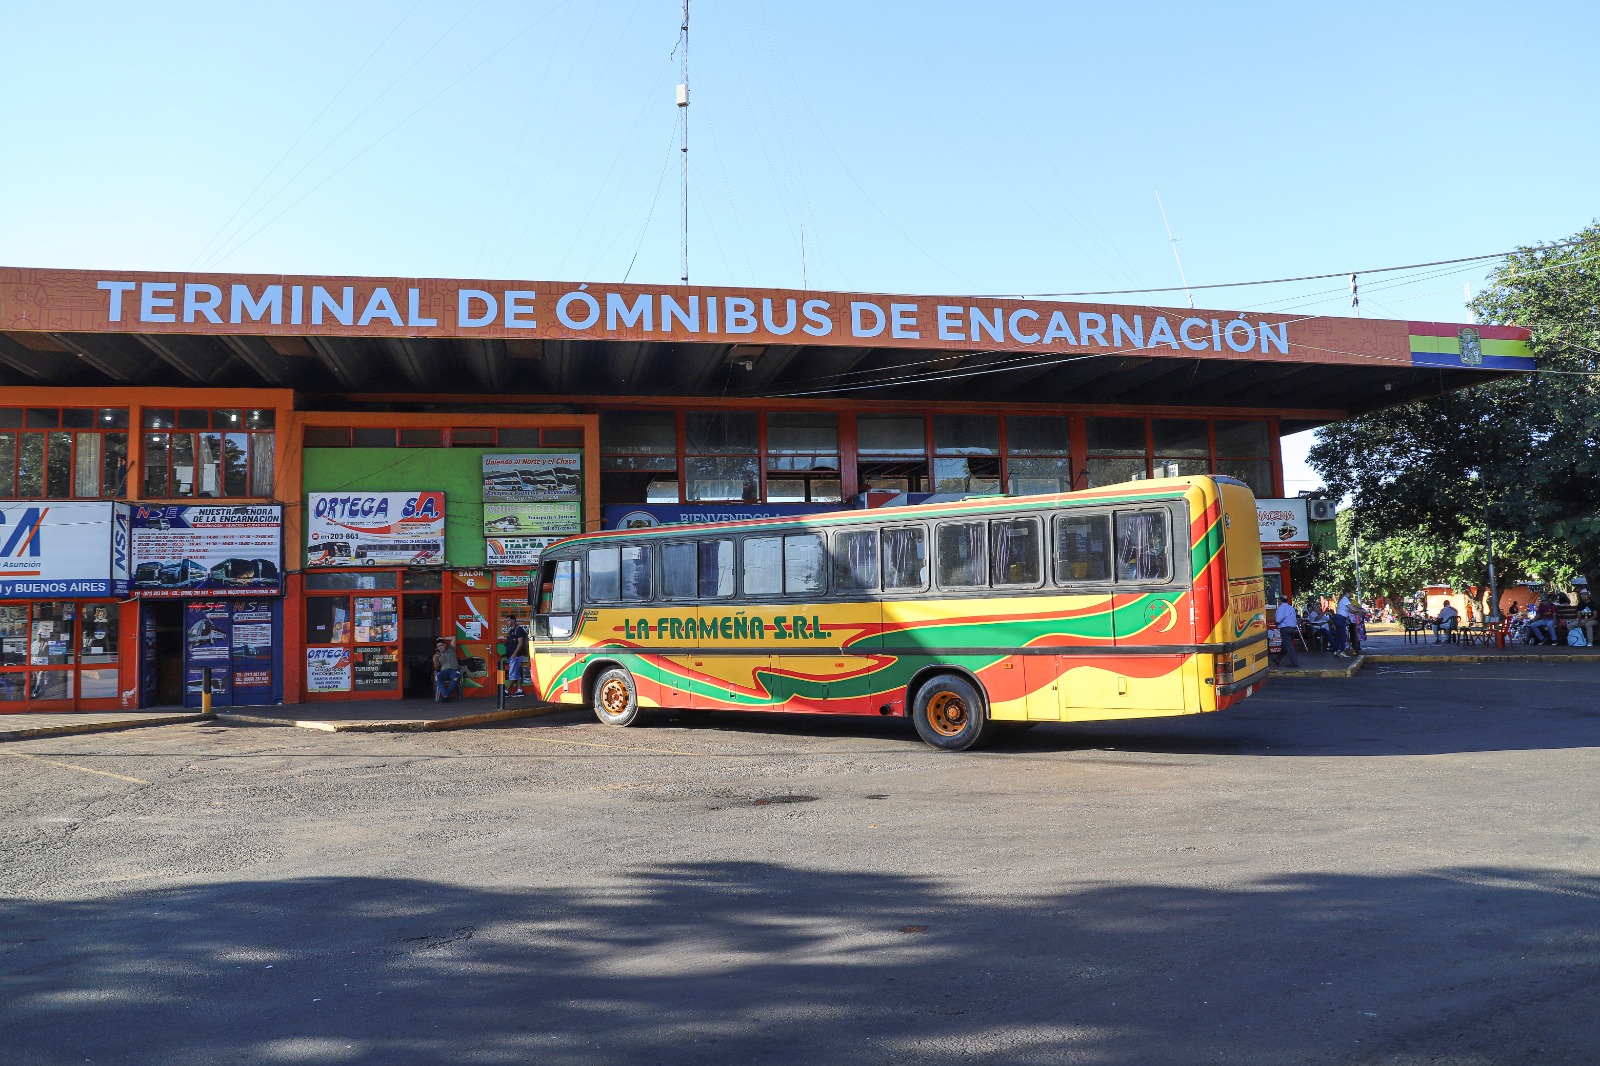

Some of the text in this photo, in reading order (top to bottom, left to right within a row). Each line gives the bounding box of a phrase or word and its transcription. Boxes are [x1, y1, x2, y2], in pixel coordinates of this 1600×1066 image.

[97, 280, 1289, 354] TERMINAL DE ÓMNIBUS DE ENCARNACIÓN
[314, 496, 440, 519] ORTEGA S.A.
[487, 504, 577, 514] CRUCERO DEL SUR
[466, 578, 475, 587] 6
[5, 586, 12, 596] y
[15, 583, 67, 593] BUENOS
[70, 582, 106, 592] AIRES
[233, 601, 269, 612] NSE
[625, 611, 832, 640] LA FRAMEÑA S.R.L.
[308, 649, 350, 660] ORTEGA
